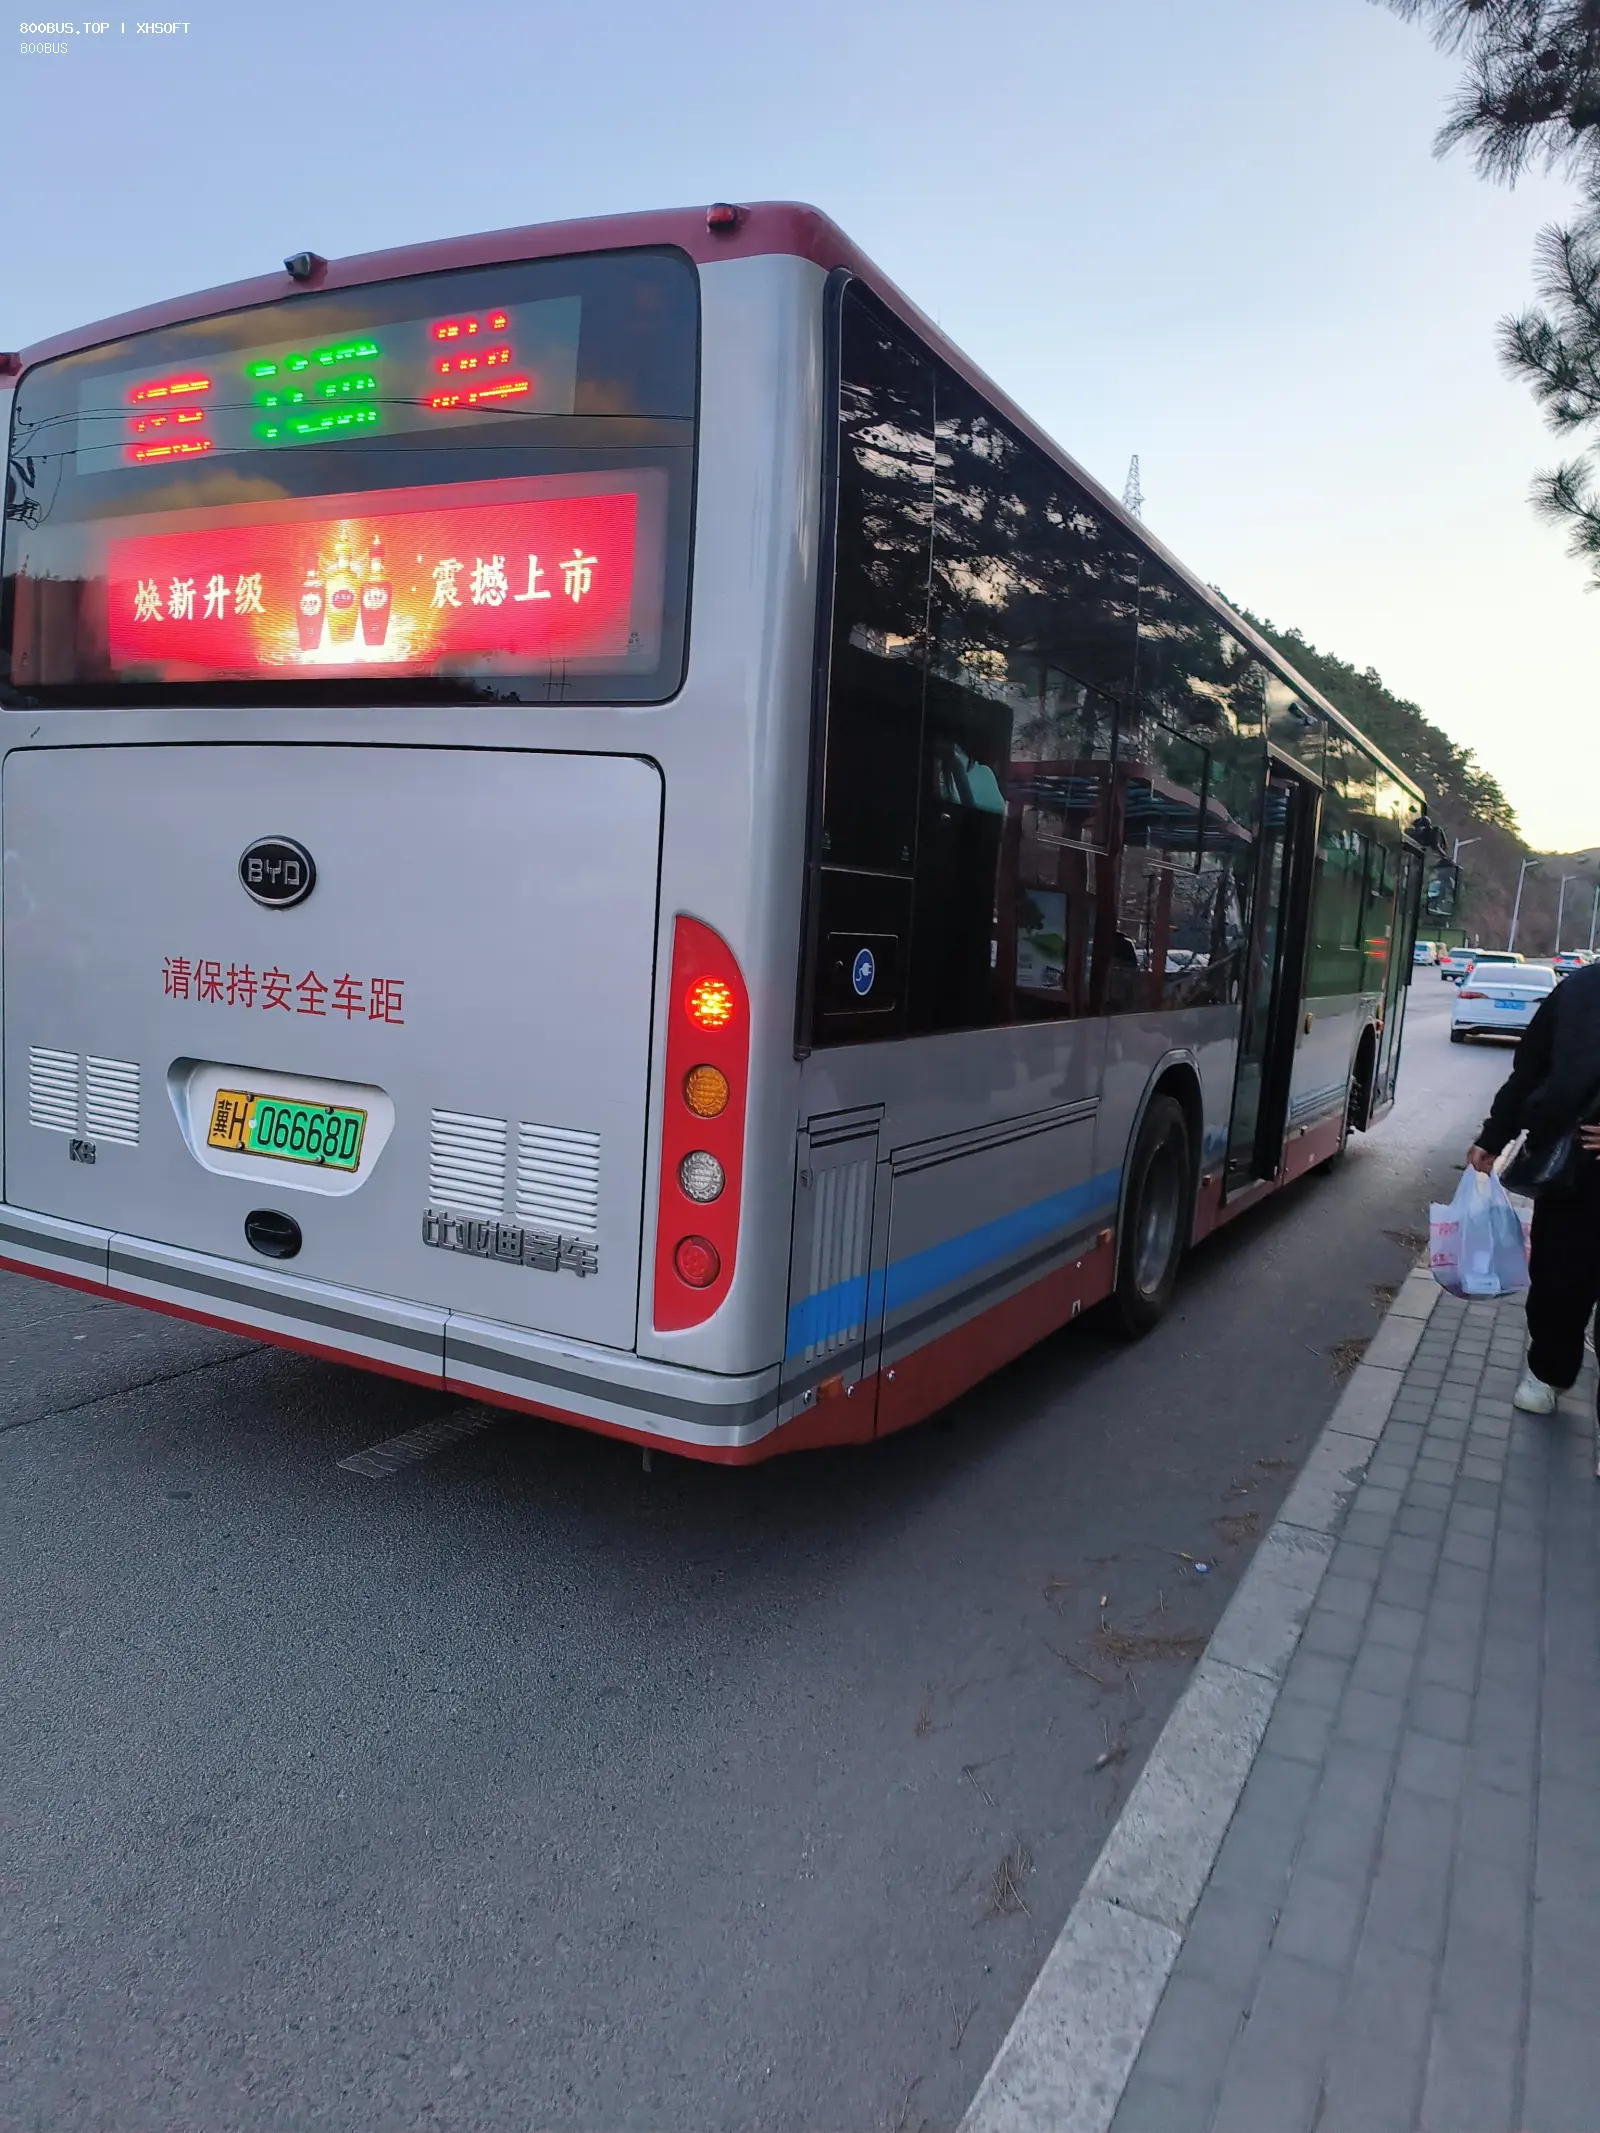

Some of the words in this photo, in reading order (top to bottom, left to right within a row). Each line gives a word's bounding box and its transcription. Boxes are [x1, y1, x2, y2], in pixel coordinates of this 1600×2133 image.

[133, 573, 266, 623] 焕新升级
[429, 548, 599, 609] 震撼上市
[247, 857, 300, 886] BYD
[162, 956, 405, 1025] 请保持安全车距
[422, 1208, 599, 1278] 比亚迪客车
